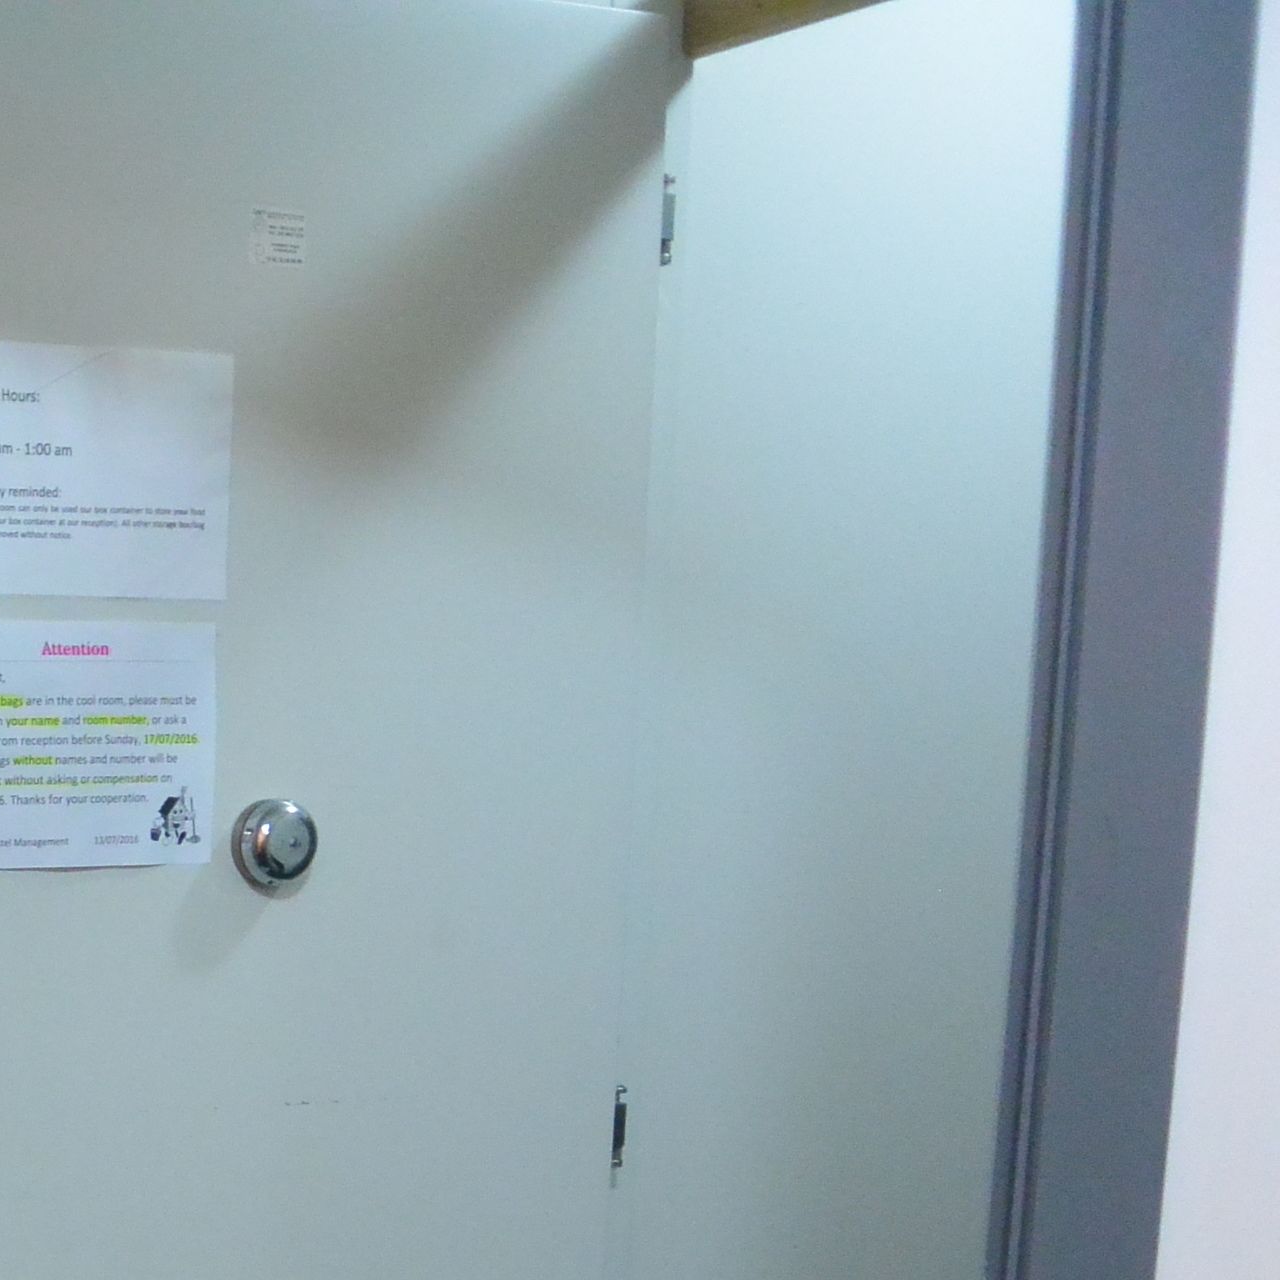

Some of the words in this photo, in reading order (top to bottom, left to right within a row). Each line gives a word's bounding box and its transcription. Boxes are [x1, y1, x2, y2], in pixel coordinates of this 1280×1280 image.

[2, 388, 40, 403] Hours:
[25, 442, 51, 456] 1:00
[54, 446, 72, 456] am
[8, 486, 62, 498] reminded:
[42, 642, 110, 656] Attention
[0, 696, 23, 709] bags
[25, 698, 42, 706] are
[44, 696, 55, 706] in
[56, 695, 74, 706] the
[75, 695, 96, 706] cool
[128, 695, 158, 708] please
[160, 697, 183, 706] must
[185, 696, 198, 706] be
[6, 719, 28, 728] your
[30, 718, 60, 726] name
[61, 715, 81, 726] and
[82, 717, 109, 726] room
[151, 717, 163, 726] or
[164, 716, 180, 725] ask
[20, 736, 69, 748] reception
[71, 734, 104, 745] before
[12, 755, 54, 766] without
[55, 756, 88, 765] names
[89, 755, 108, 765] and
[109, 754, 147, 765] number
[148, 754, 164, 764] will
[166, 753, 179, 764] be
[4, 775, 44, 786] without
[46, 774, 80, 787] asking
[80, 776, 92, 785] or
[92, 774, 159, 785] compensation
[160, 775, 173, 784] on
[10, 795, 47, 806] Thanks
[48, 794, 64, 805] for
[66, 796, 90, 806] your
[90, 794, 150, 806] cooperation.
[13, 837, 70, 848] Management
